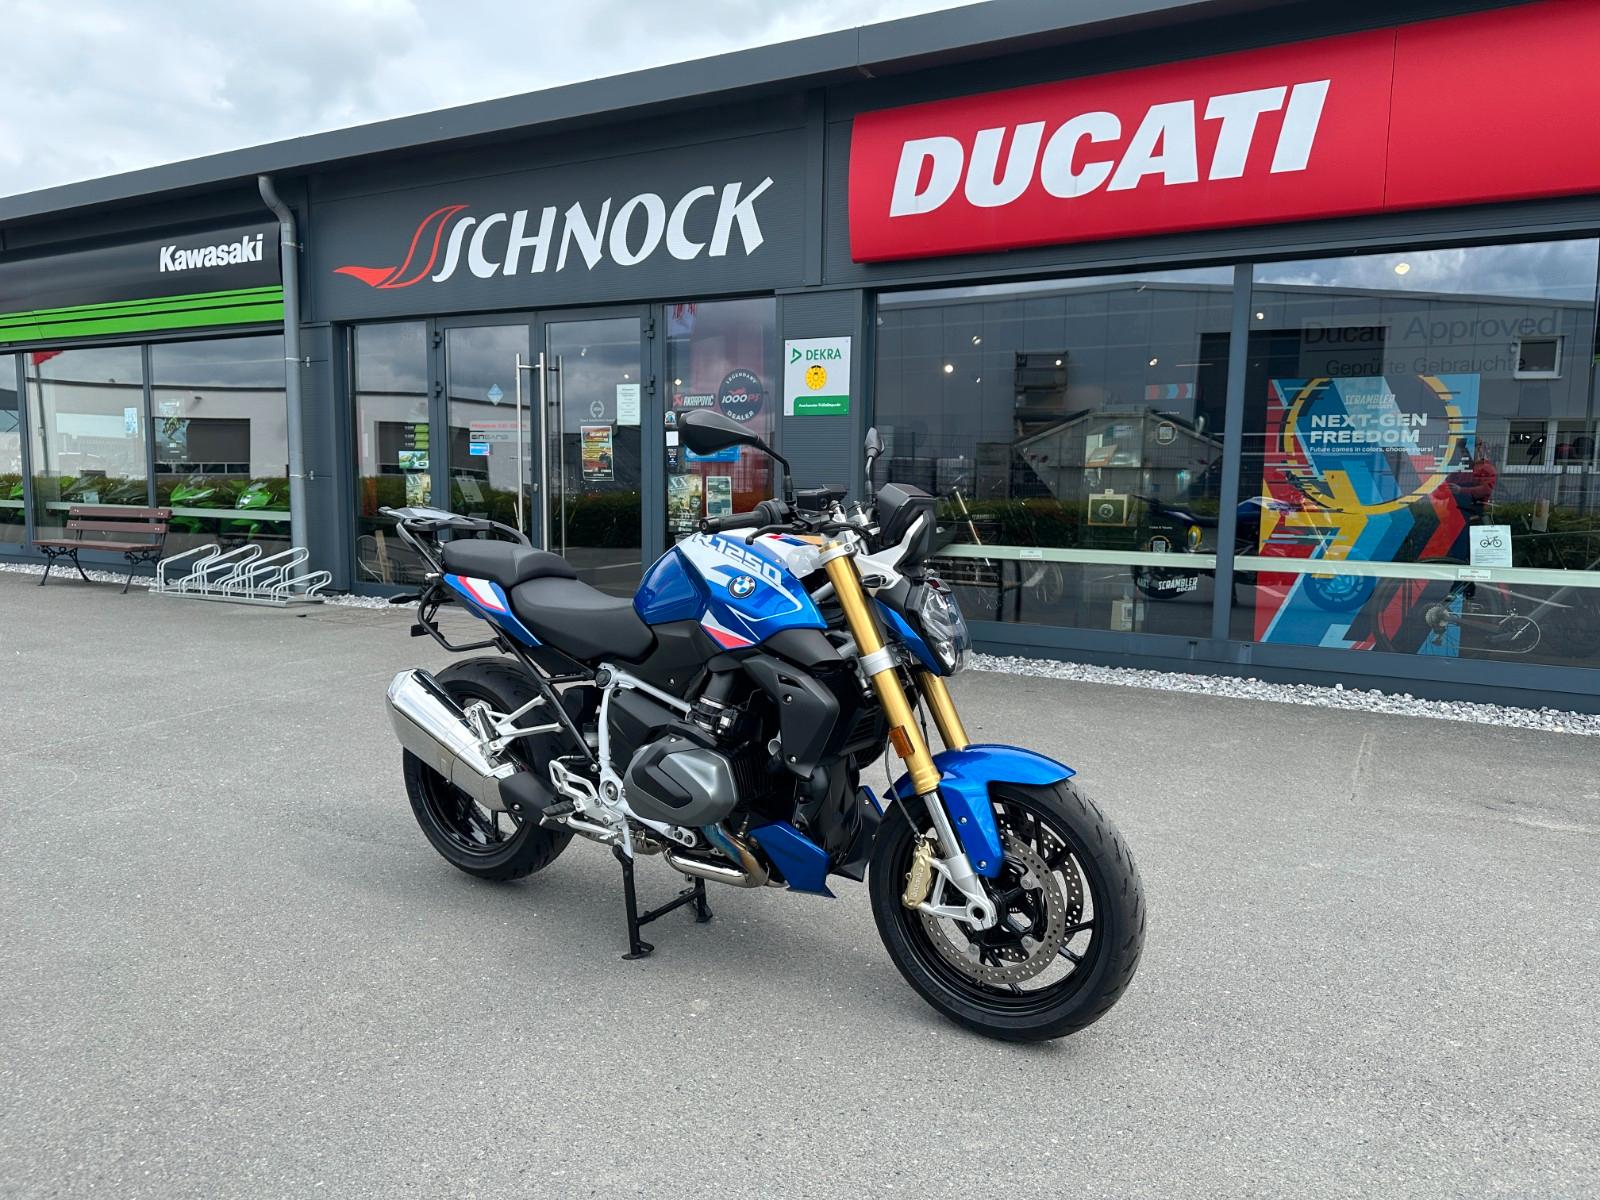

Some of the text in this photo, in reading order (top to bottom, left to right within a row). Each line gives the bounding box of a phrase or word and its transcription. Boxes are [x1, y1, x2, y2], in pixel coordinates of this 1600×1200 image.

[889, 79, 1331, 217] DUCATI
[431, 177, 774, 283] SCHNOCK
[159, 233, 264, 272] Kawasaki
[1303, 311, 1559, 344] Ducati Approved
[806, 348, 842, 360] DEKRA
[1325, 354, 1526, 379] Geprüte Gebrauchte
[725, 372, 757, 384] LEGENDARY
[727, 410, 754, 421] DEALER
[1311, 413, 1428, 428] NEXT-GEN
[1310, 429, 1420, 443] FREEDOM
[714, 537, 782, 588] 1250
[1158, 577, 1199, 591] SCRAMBLER
